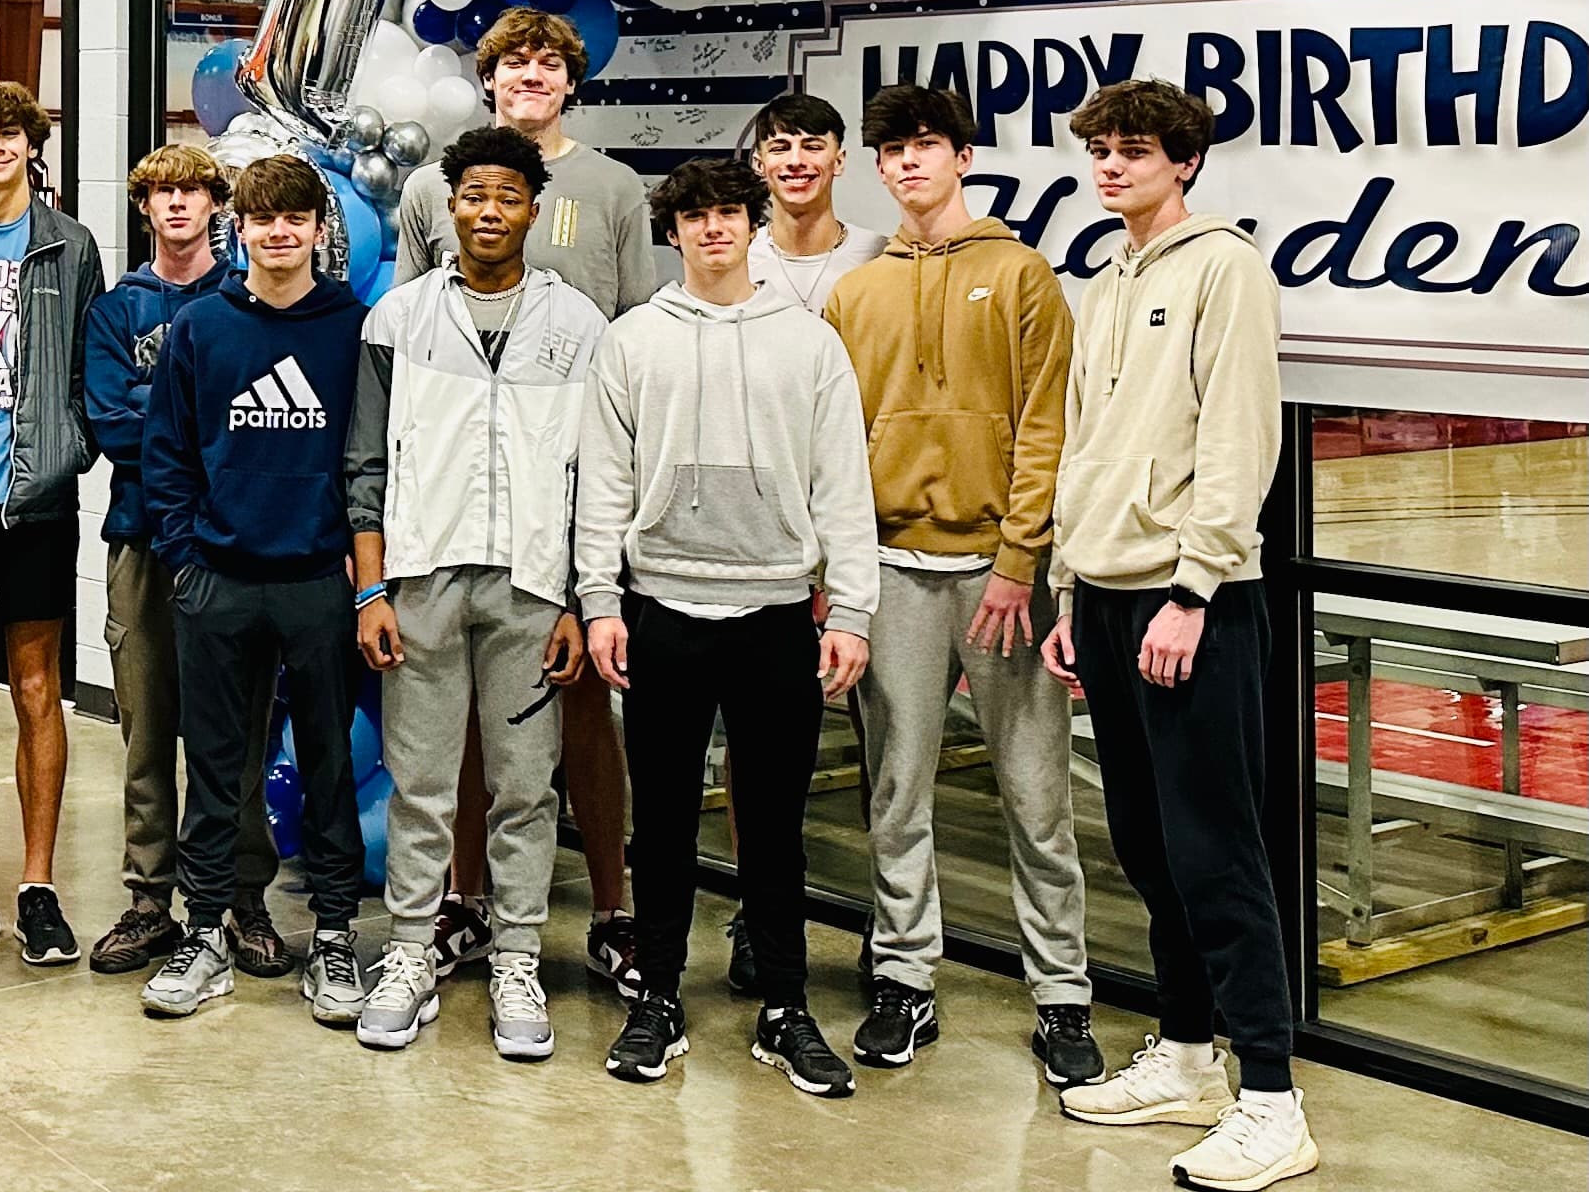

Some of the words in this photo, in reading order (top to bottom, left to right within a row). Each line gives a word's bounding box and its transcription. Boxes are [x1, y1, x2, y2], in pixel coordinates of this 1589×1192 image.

[200, 13, 223, 22] BONUS
[1184, 21, 1589, 153] BIRTHD
[961, 173, 1589, 296] Haden
[229, 407, 327, 431] patriots
